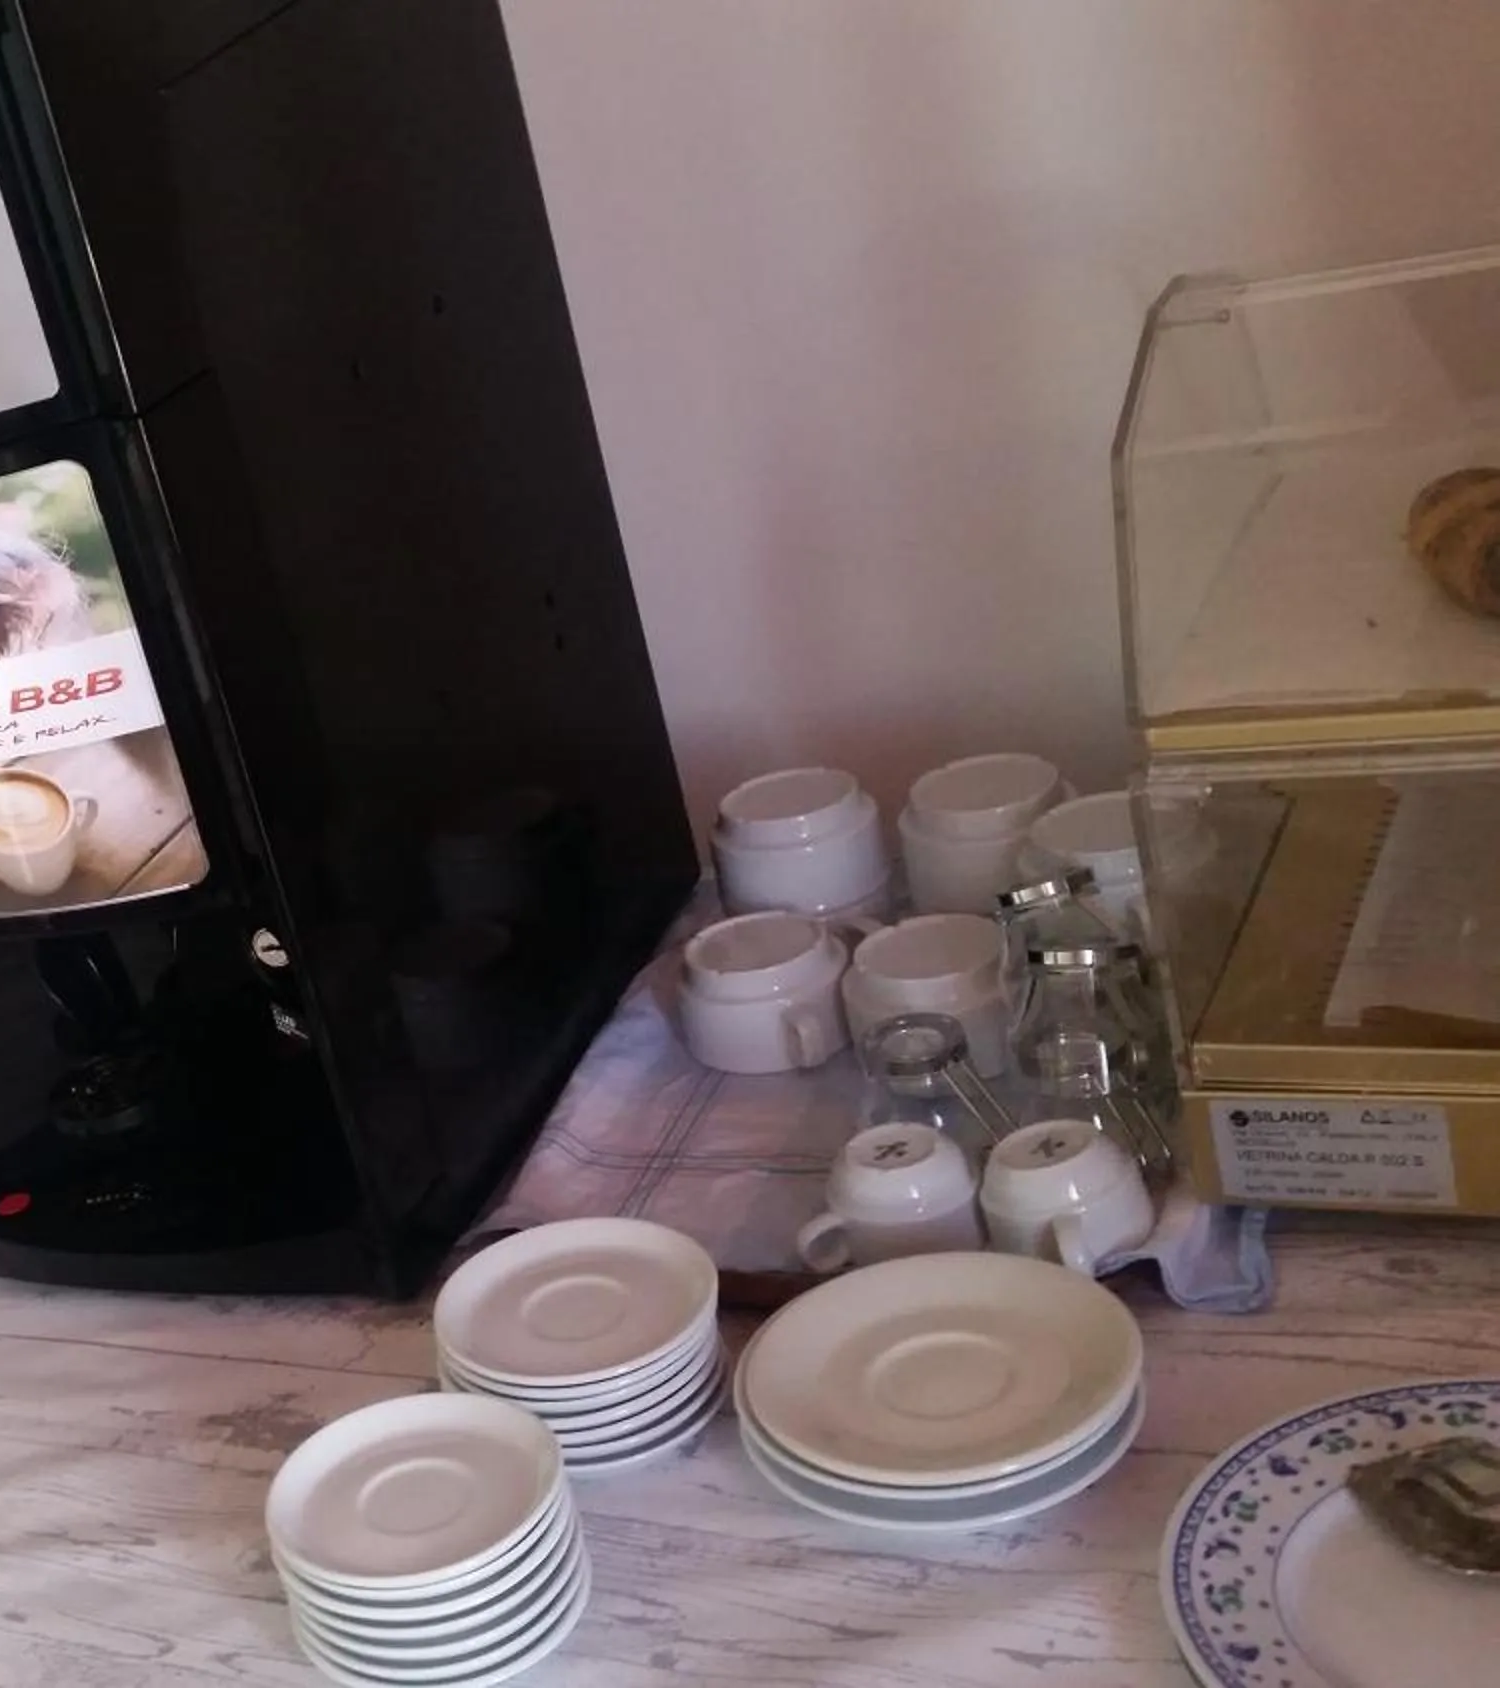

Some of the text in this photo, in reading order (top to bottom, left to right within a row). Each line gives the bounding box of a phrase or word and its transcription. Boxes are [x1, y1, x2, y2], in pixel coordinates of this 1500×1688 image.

[10, 668, 124, 714] B&B
[13, 734, 25, 746] E
[1251, 1109, 1331, 1125] SILANOS
